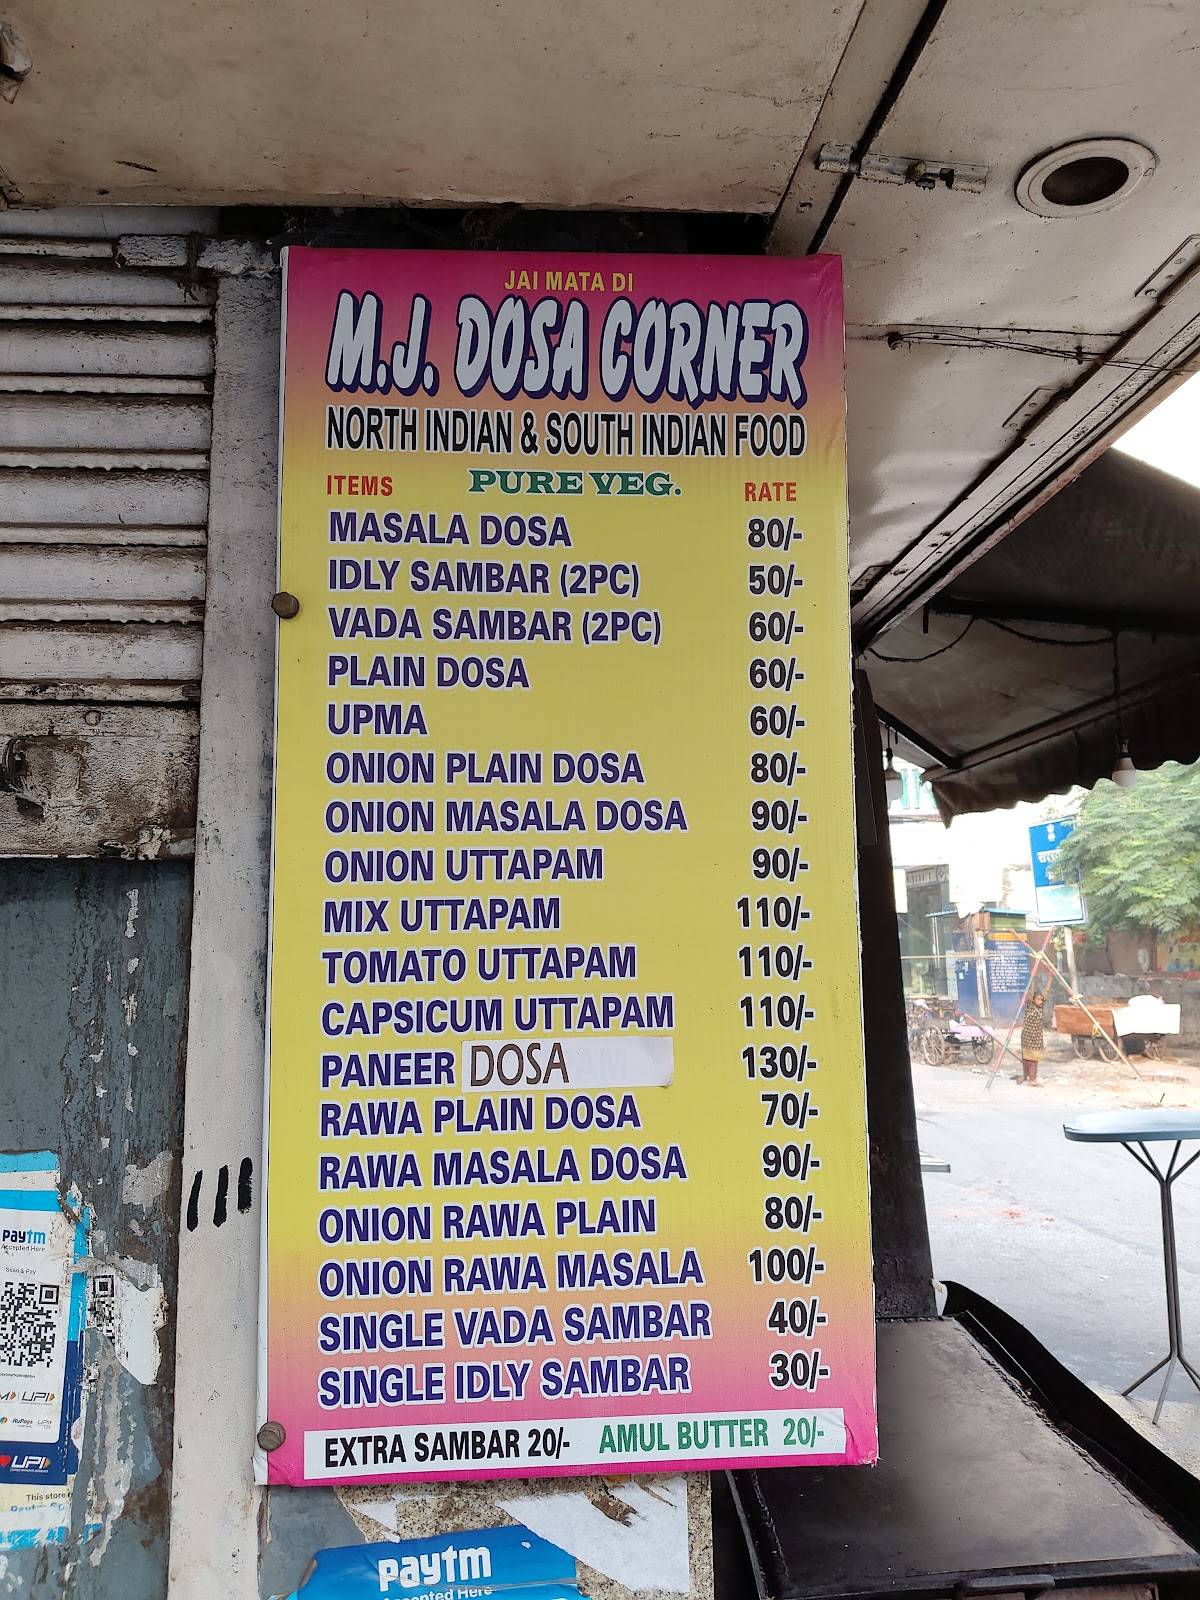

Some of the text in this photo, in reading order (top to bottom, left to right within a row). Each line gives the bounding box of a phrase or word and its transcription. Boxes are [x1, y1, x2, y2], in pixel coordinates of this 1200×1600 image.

[504, 270, 633, 292] JAI MATA DI
[325, 289, 809, 410] M.J. DOSA CORNER
[327, 406, 805, 457] NORTH INDIAN & SOUTH INDIAN FOOD
[326, 475, 393, 497] ITEMS
[468, 469, 682, 496] PURE VEG.
[744, 482, 797, 502] RATE
[329, 511, 803, 551] MASALA DOSA 80/-
[329, 559, 803, 598] IDLY SAMBAR (2PC) 50/-
[328, 607, 804, 645] VADA SAMBAR (2PC) 60/-
[328, 656, 805, 692] PLAIN DOSA 60/-
[328, 704, 806, 739] UPMA 60/-
[326, 752, 806, 786] ONION PLAIN DOSA 80/-
[325, 799, 807, 834] ONION MASALA DOSA 90/-
[325, 847, 809, 882] ONION UTTAPAM 90/-
[324, 895, 810, 933] MIX UTTAPAM 110/-
[322, 944, 812, 984] TOMATO UTTAPAM 110/-
[321, 994, 814, 1035] CAPSICUM UTTAPAM 110/-
[321, 1042, 817, 1088] PANEER DOSA 130/-
[320, 1092, 818, 1136] RAWA PLAIN DOSA 70/-
[320, 1143, 820, 1190] RAWA MASALA DOSA 90/-
[319, 1195, 822, 1244] ONION RAWA PLAIN 80/-
[319, 1247, 825, 1298] ONION RAWA MASALA 100/-
[319, 1298, 827, 1352] SINGLE VADA SAMBAR 40/-
[22, 1391, 52, 1402] UPI
[319, 1351, 829, 1407] SINGLE IDLY SAMBAR 30/-
[324, 1425, 570, 1469] EXTRA SAMBAR 20/-
[599, 1415, 824, 1454] AMUL BUTTER 20/-
[11, 1455, 48, 1469] UPI
[26, 1494, 44, 1502] This
[45, 1492, 66, 1500] store
